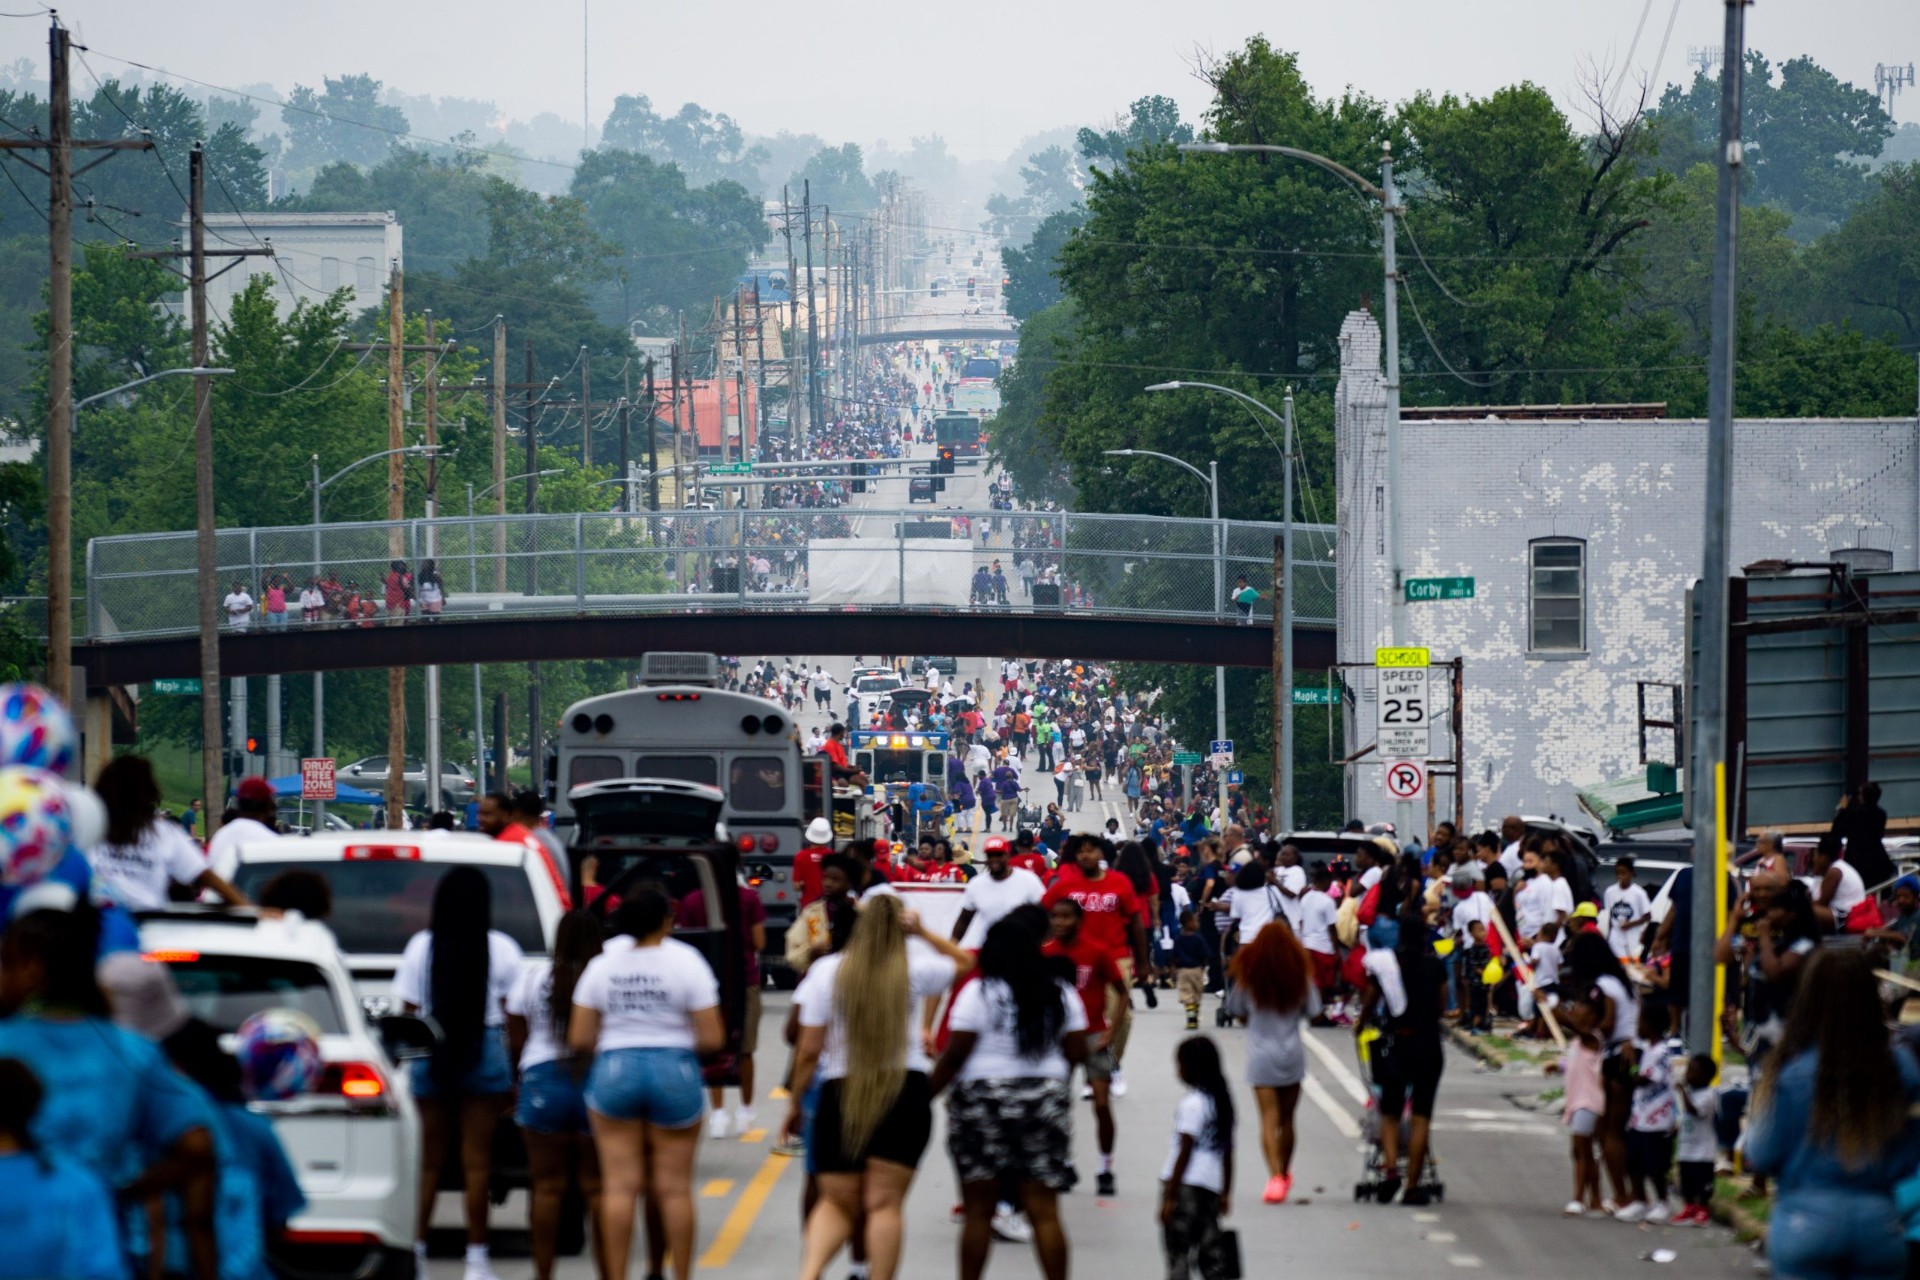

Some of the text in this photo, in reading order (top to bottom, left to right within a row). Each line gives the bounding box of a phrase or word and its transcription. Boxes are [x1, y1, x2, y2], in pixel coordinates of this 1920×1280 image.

[1409, 581, 1443, 599] Corby
[1380, 652, 1424, 665] SCHOOL
[1382, 670, 1424, 681] SPEED
[155, 680, 180, 693] Maple
[1386, 684, 1419, 695] LIMIT
[1294, 690, 1318, 703] Maple
[1383, 699, 1423, 723] 25
[1381, 738, 1411, 746] CHILDREN
[304, 760, 334, 770] DRUG
[305, 770, 331, 780] FREE
[304, 780, 334, 790] ZONE
